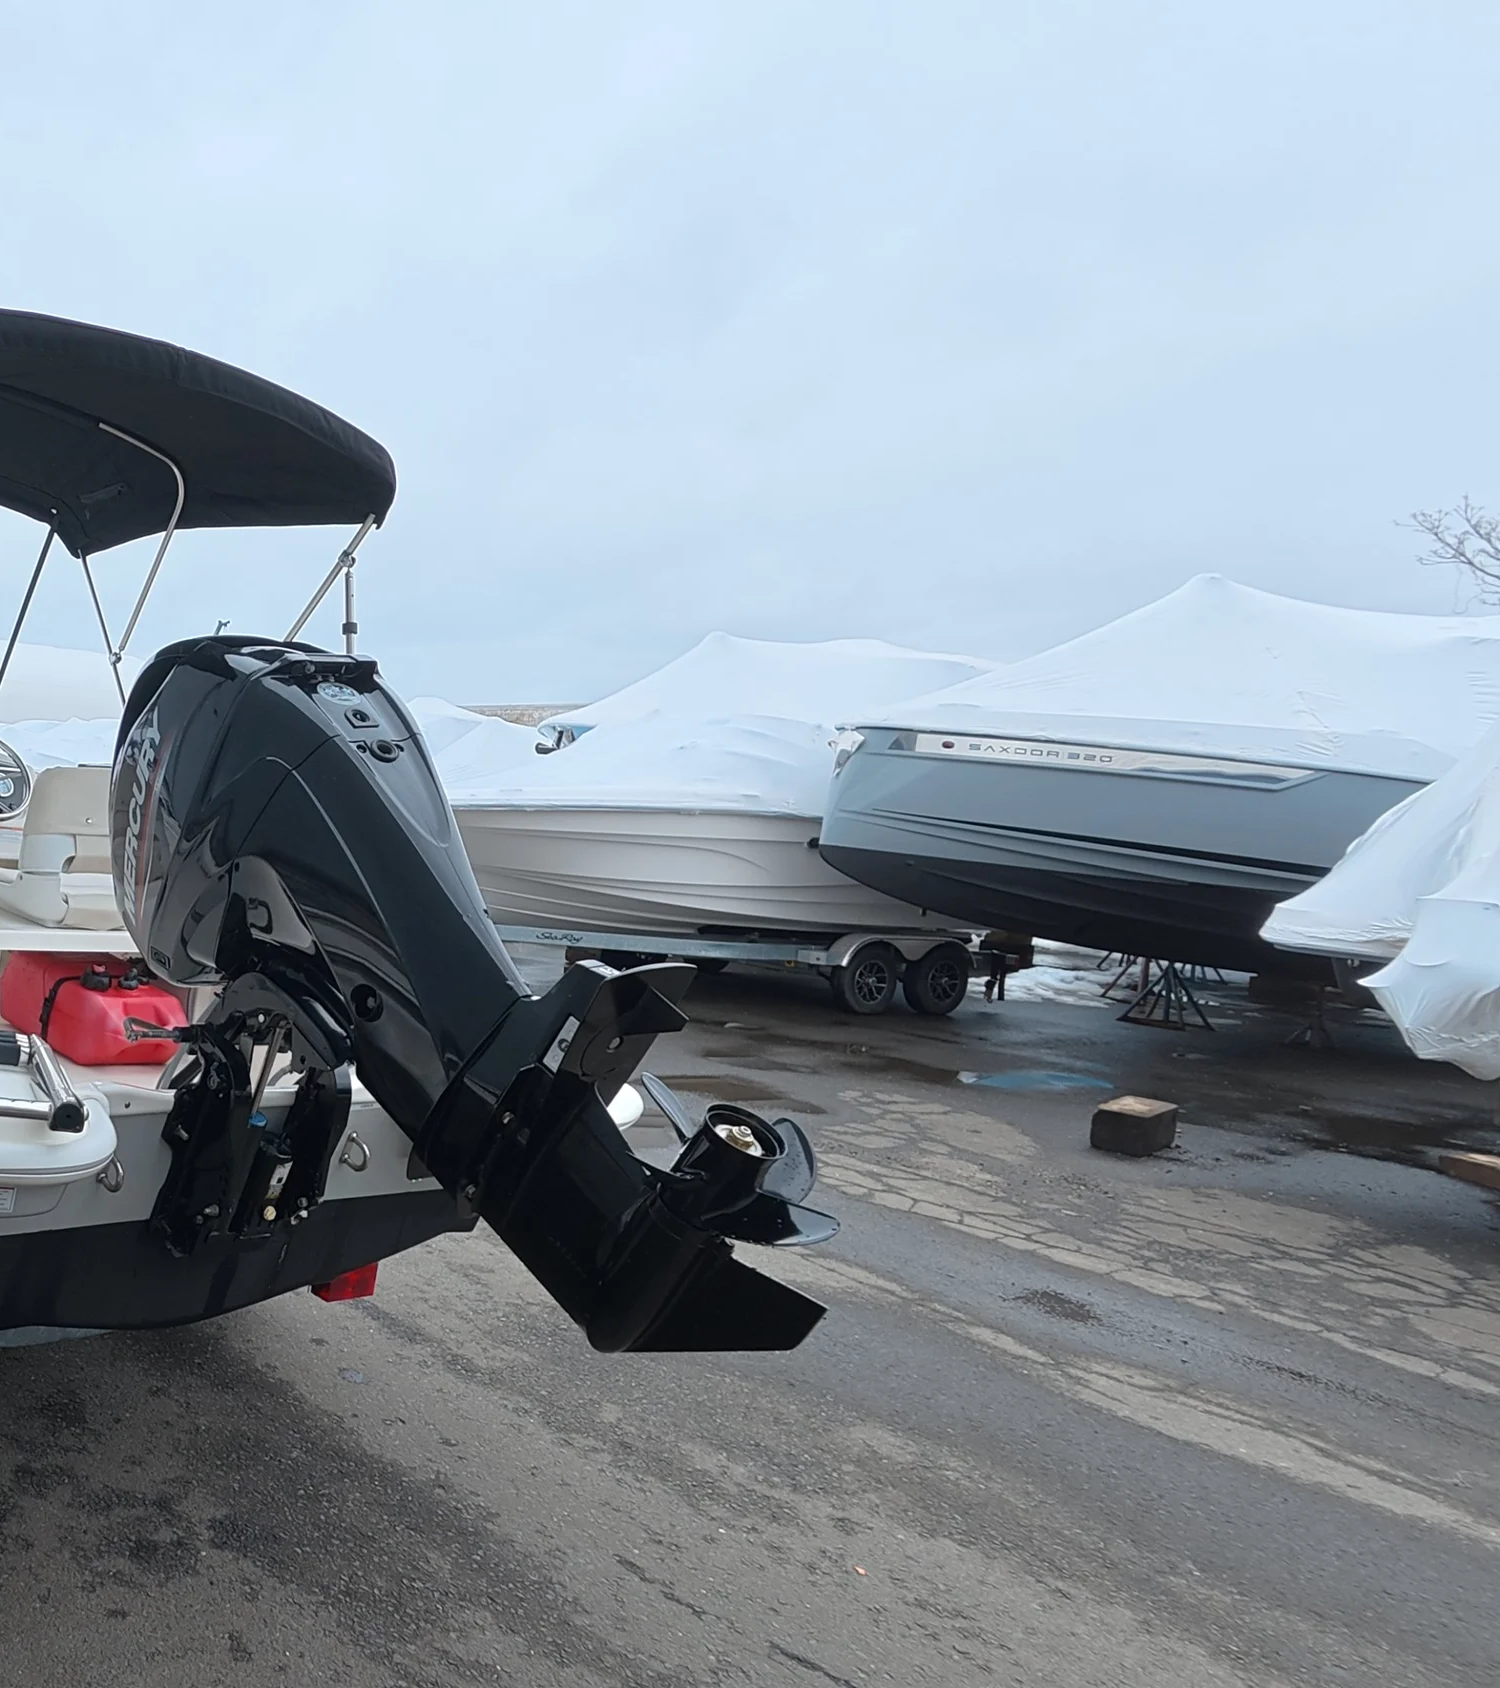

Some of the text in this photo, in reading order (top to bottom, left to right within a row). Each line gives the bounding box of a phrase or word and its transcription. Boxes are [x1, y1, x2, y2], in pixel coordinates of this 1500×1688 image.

[968, 743, 1113, 763] SAXDOR 320
[123, 706, 162, 925] MERCURY
